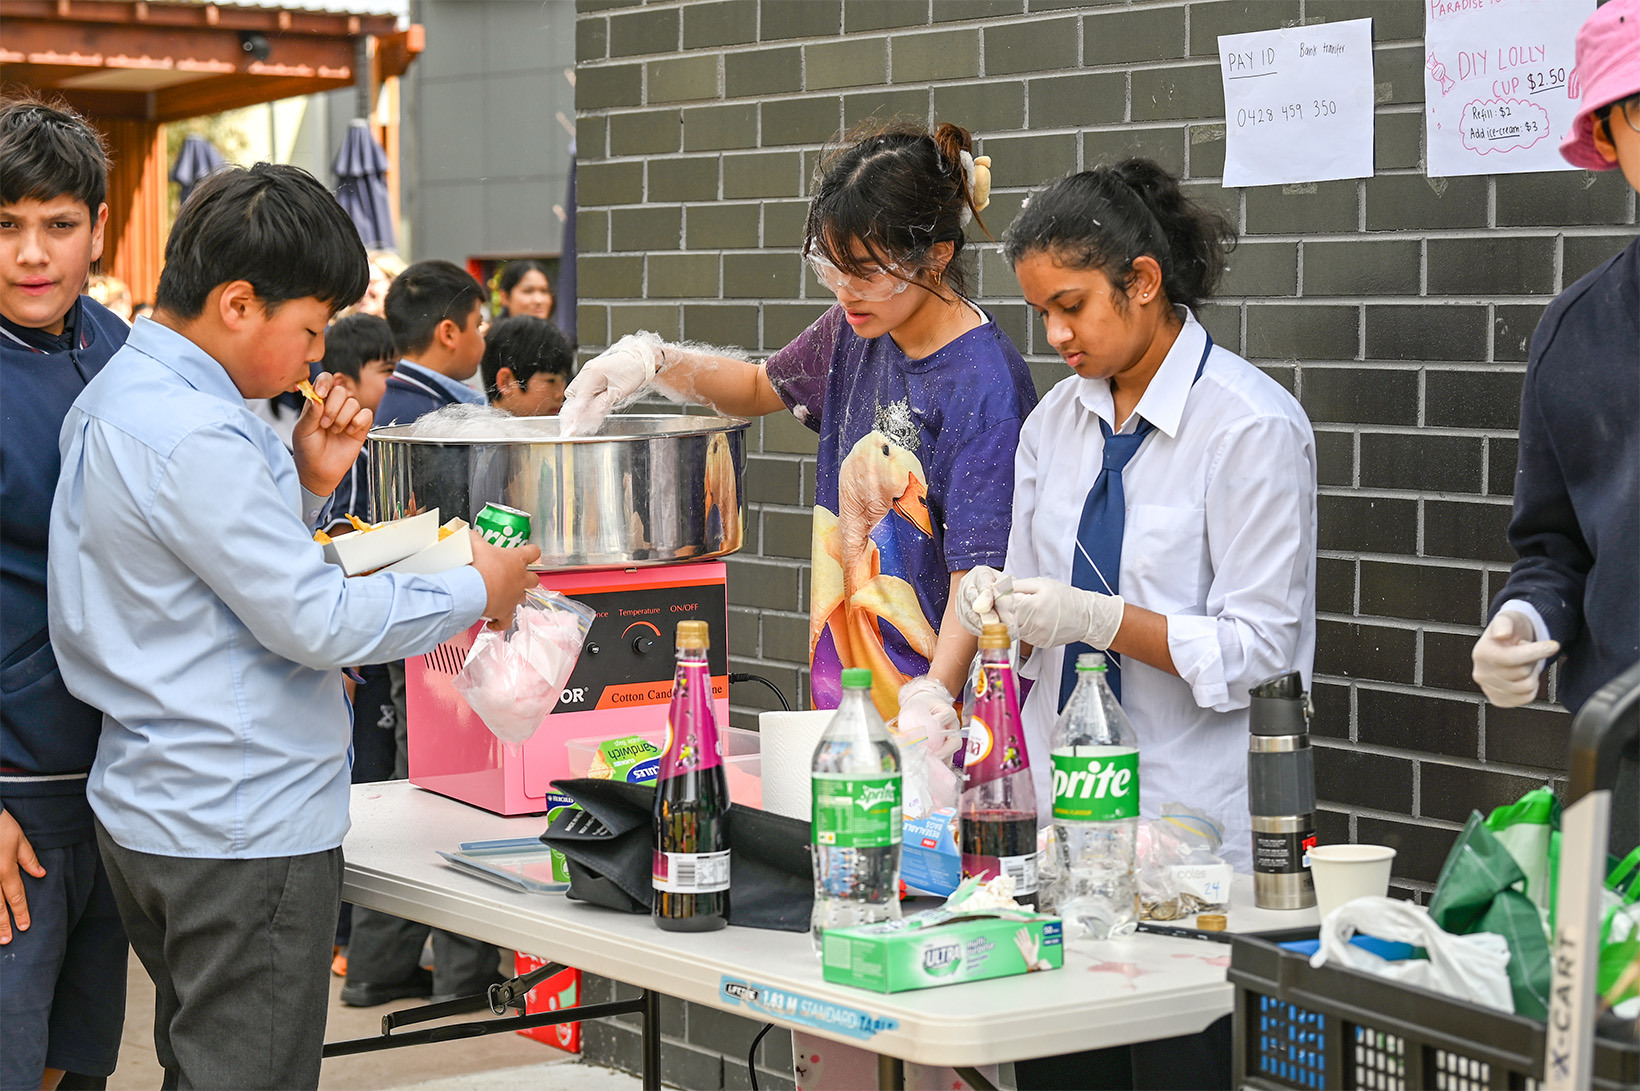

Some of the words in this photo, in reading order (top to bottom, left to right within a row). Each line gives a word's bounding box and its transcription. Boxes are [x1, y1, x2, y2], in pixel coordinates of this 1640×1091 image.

[1228, 51, 1253, 71] PAY
[1262, 47, 1275, 66] ID
[1299, 42, 1317, 58] Bank
[1323, 42, 1346, 57] transfer
[1458, 50, 1487, 80] DIY
[1499, 44, 1545, 70] LOLLY
[1492, 77, 1519, 98] CUP
[1527, 67, 1566, 91] $2.50
[1237, 108, 1274, 127] 0428
[1282, 103, 1303, 122] 459
[1313, 99, 1337, 117] 350
[1499, 106, 1512, 118] $2
[1470, 127, 1486, 140] Add
[1524, 121, 1539, 133] $3
[475, 525, 529, 549] rit
[619, 606, 661, 617] Temperature
[670, 603, 699, 613] ON/OFF
[611, 690, 645, 704] Cotton
[647, 687, 673, 700] Cand
[608, 742, 658, 760] Sandwich
[632, 764, 660, 780] CULES
[1204, 880, 1220, 900] 24
[800, 1000, 858, 1029] STANDARD
